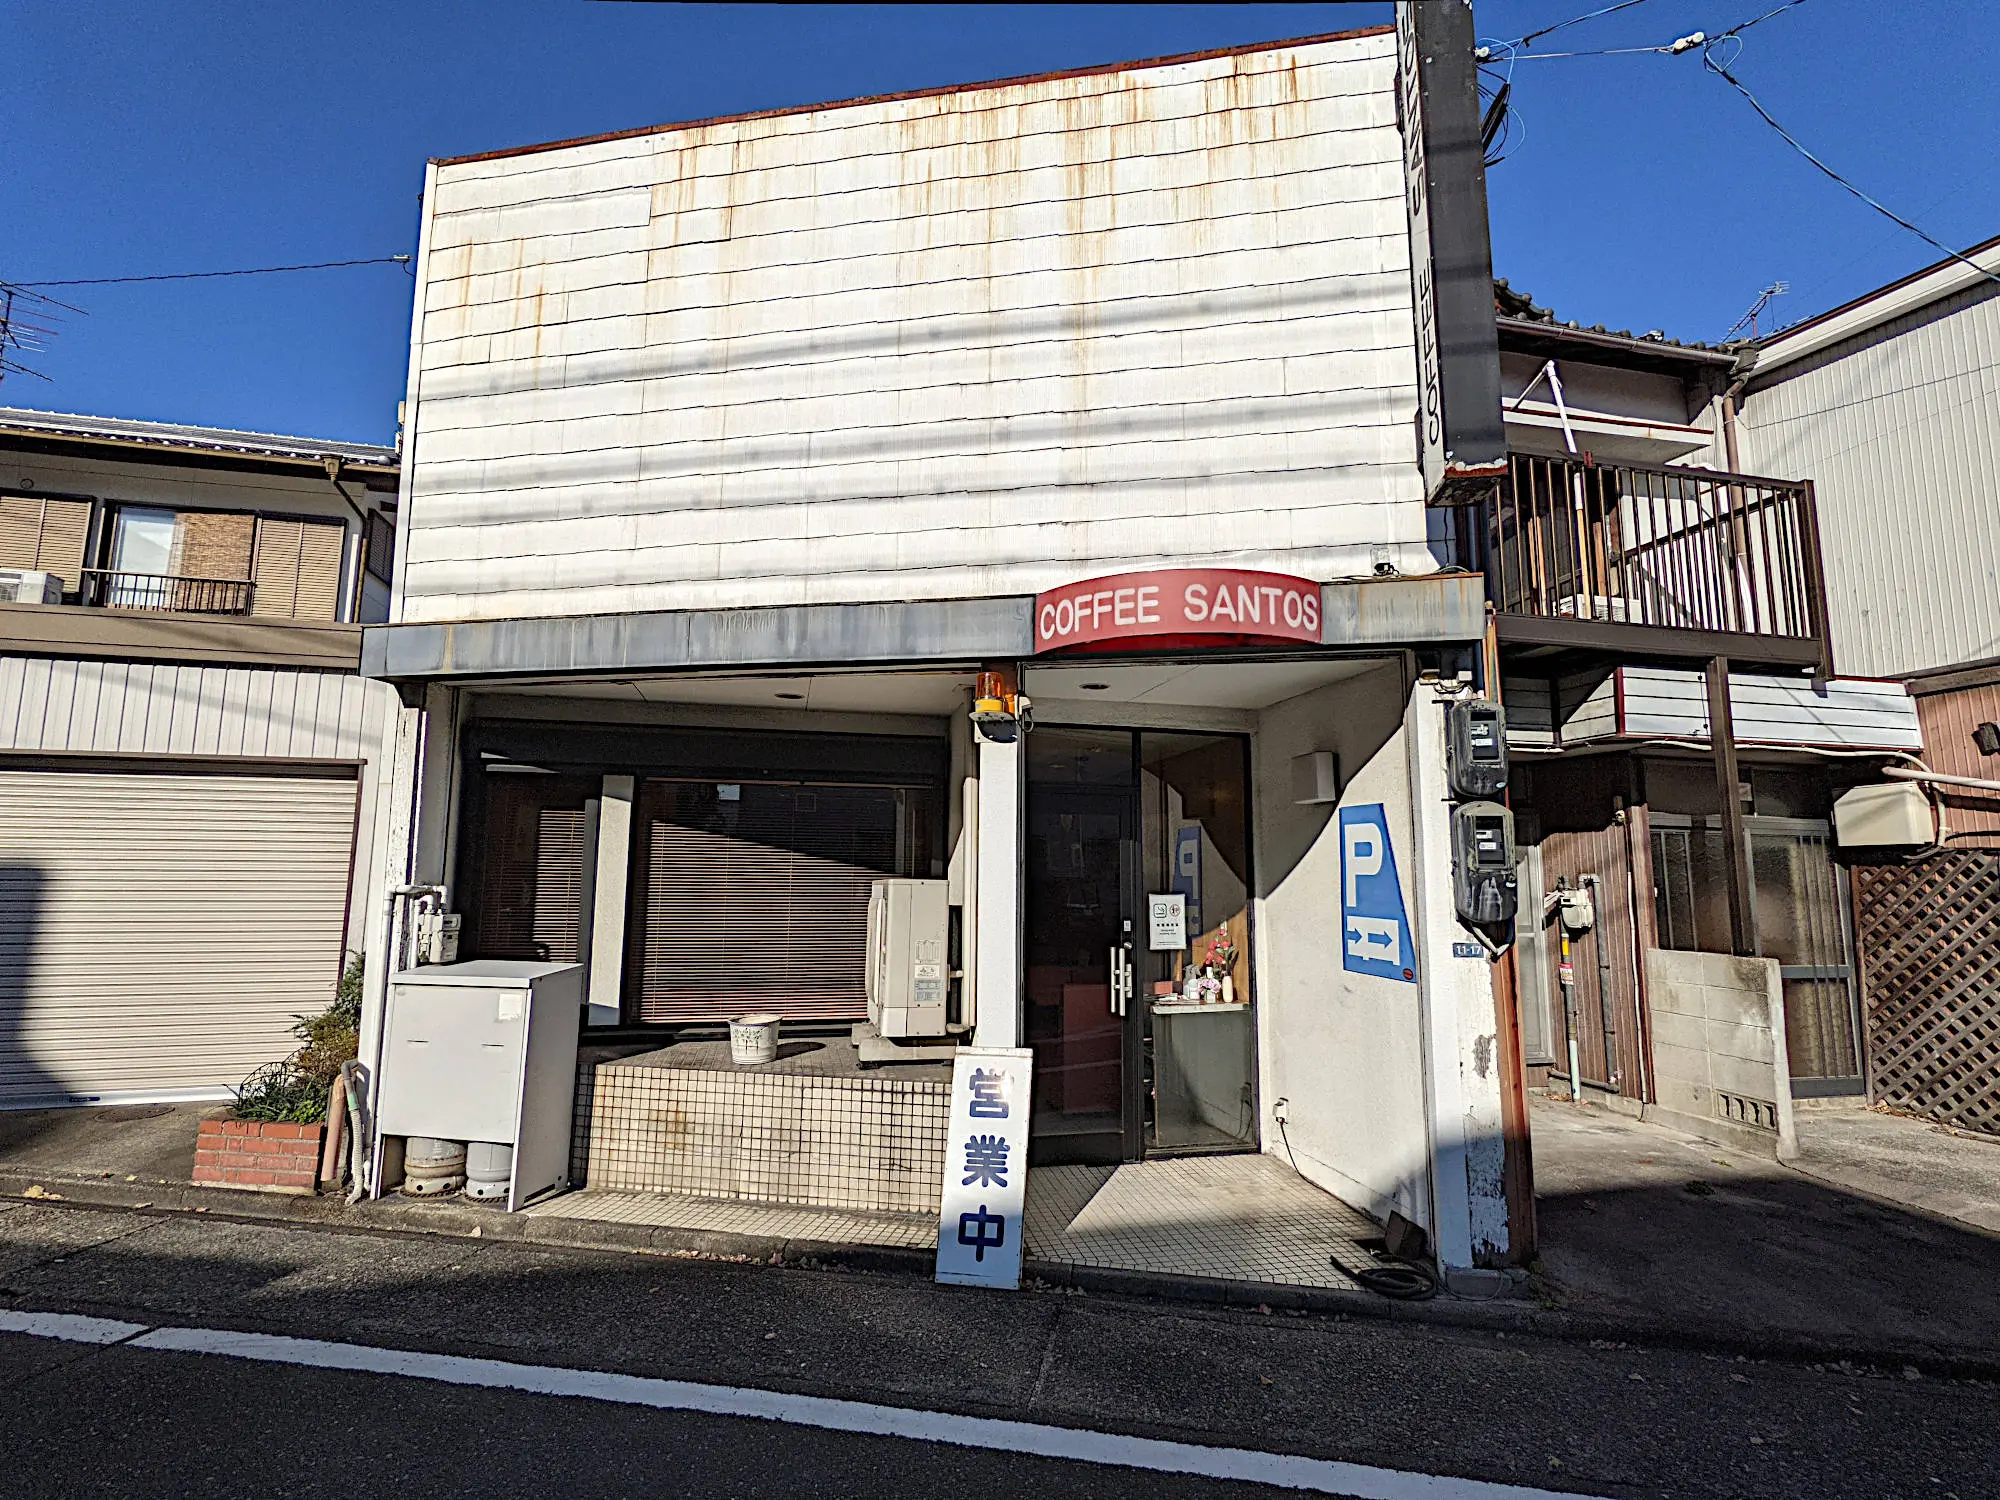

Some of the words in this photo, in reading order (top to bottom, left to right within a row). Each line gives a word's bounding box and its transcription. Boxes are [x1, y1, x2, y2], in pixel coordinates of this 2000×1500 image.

[1419, 258, 1440, 446] COFFEE
[1039, 585, 1161, 640] COFFEE
[1183, 583, 1319, 632] SANTOS
[1344, 822, 1383, 908] P
[1456, 945, 1481, 955] 11-17
[957, 1067, 1015, 1263] 営業中
